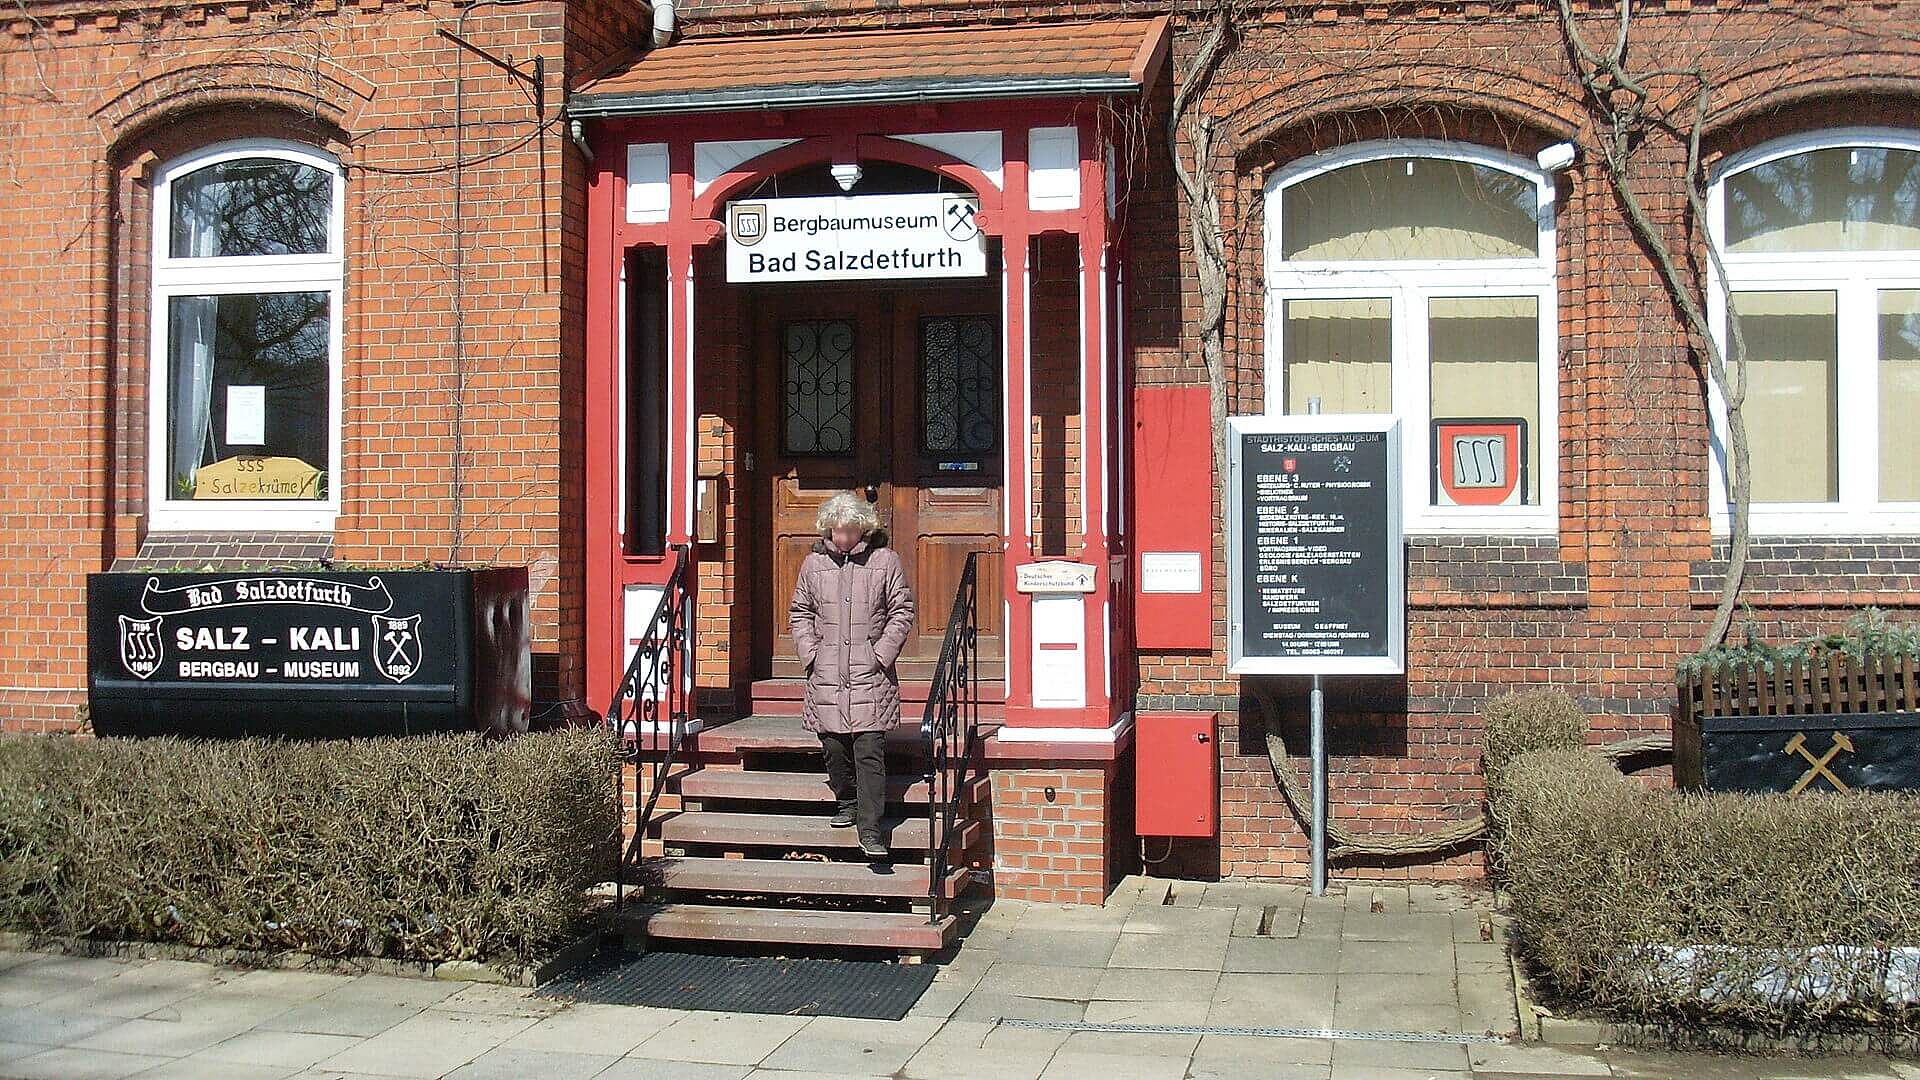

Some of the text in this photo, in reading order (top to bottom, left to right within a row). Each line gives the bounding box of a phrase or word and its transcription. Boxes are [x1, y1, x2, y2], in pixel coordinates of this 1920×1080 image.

[773, 214, 938, 236] Bergbaumuseum
[748, 247, 962, 273] Bad Salzdetfurth
[238, 459, 264, 472] SSS
[1256, 474, 1299, 483] EBENE 3
[1256, 506, 1300, 515] EBENE 2
[1257, 536, 1298, 545] EBENE 1
[1256, 574, 1298, 583] EBENE K
[186, 581, 352, 607] Bad Salzdetfurth
[176, 627, 250, 651] SALZ
[290, 626, 360, 651] KALI
[179, 661, 260, 678] BERGBAU
[284, 661, 360, 678] MUSEUM
